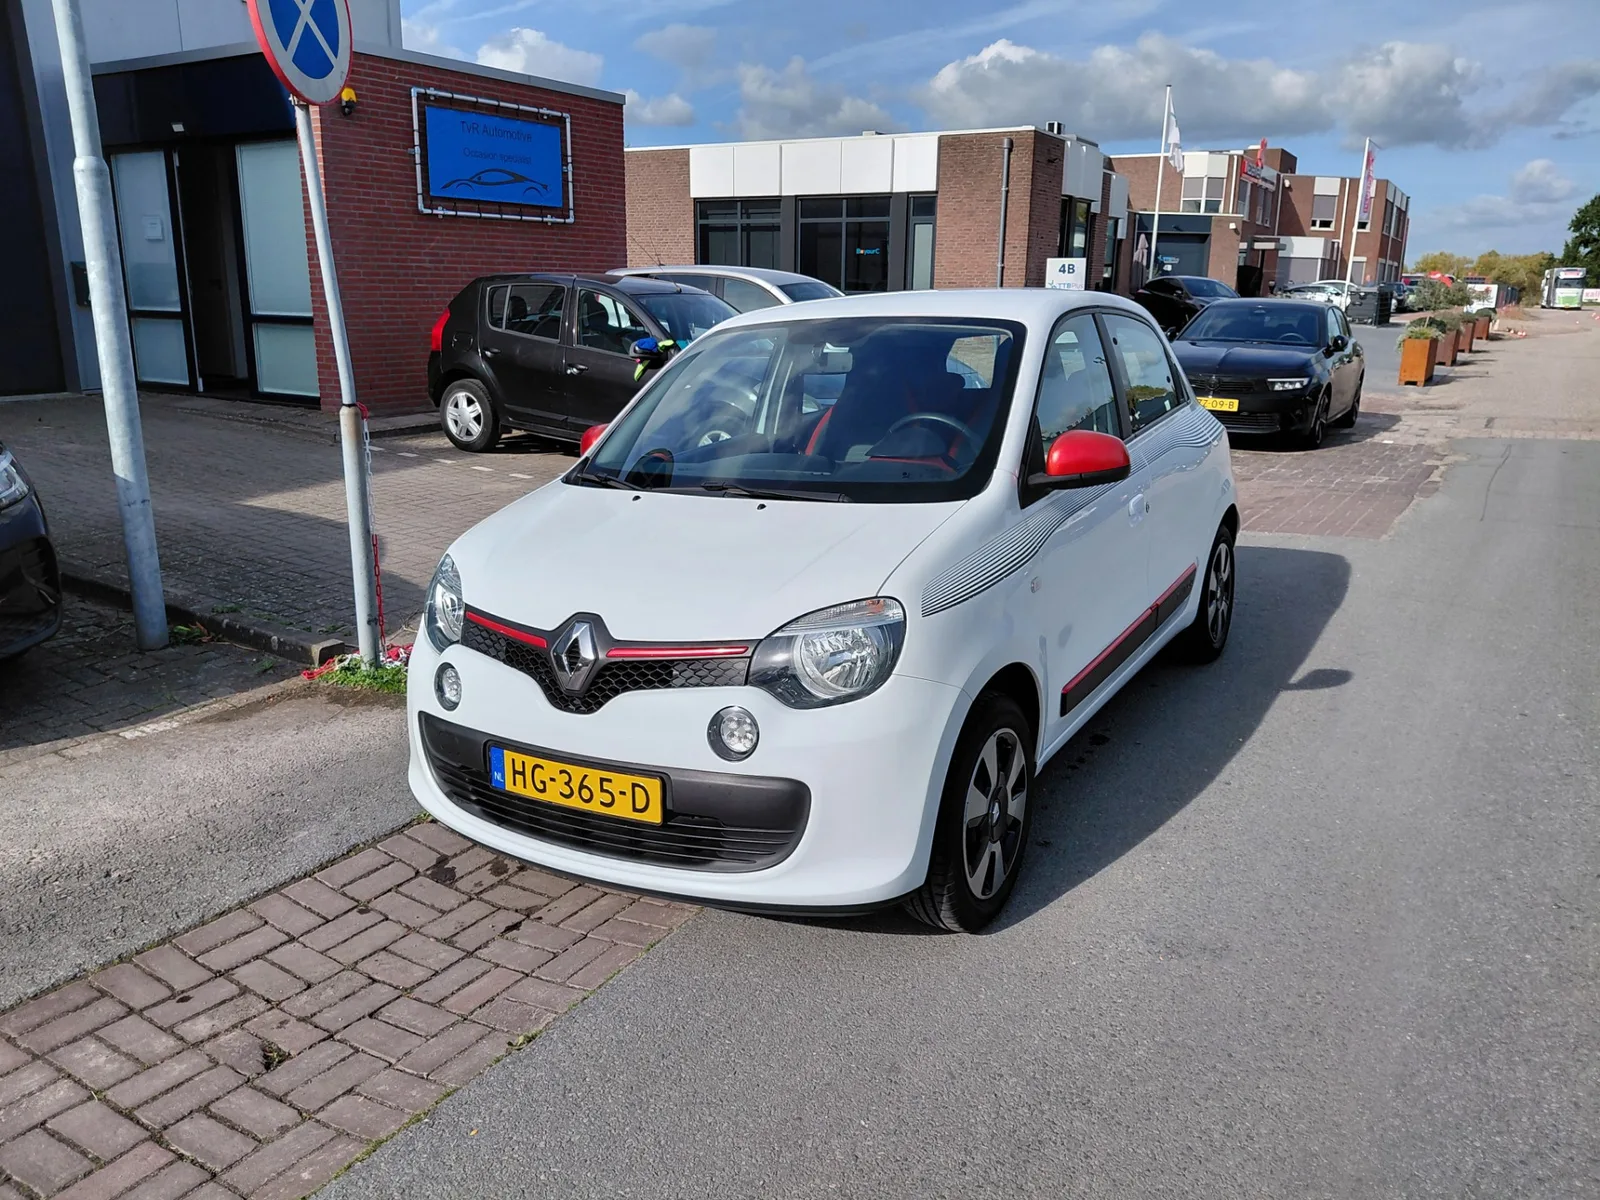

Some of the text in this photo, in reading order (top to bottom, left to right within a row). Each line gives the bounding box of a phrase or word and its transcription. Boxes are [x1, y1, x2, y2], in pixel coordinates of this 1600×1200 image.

[482, 124, 533, 142] Automotive
[463, 147, 498, 160] Occasion
[1058, 263, 1076, 275] 4B
[494, 770, 504, 783] NL
[511, 757, 651, 814] HG-365-D
